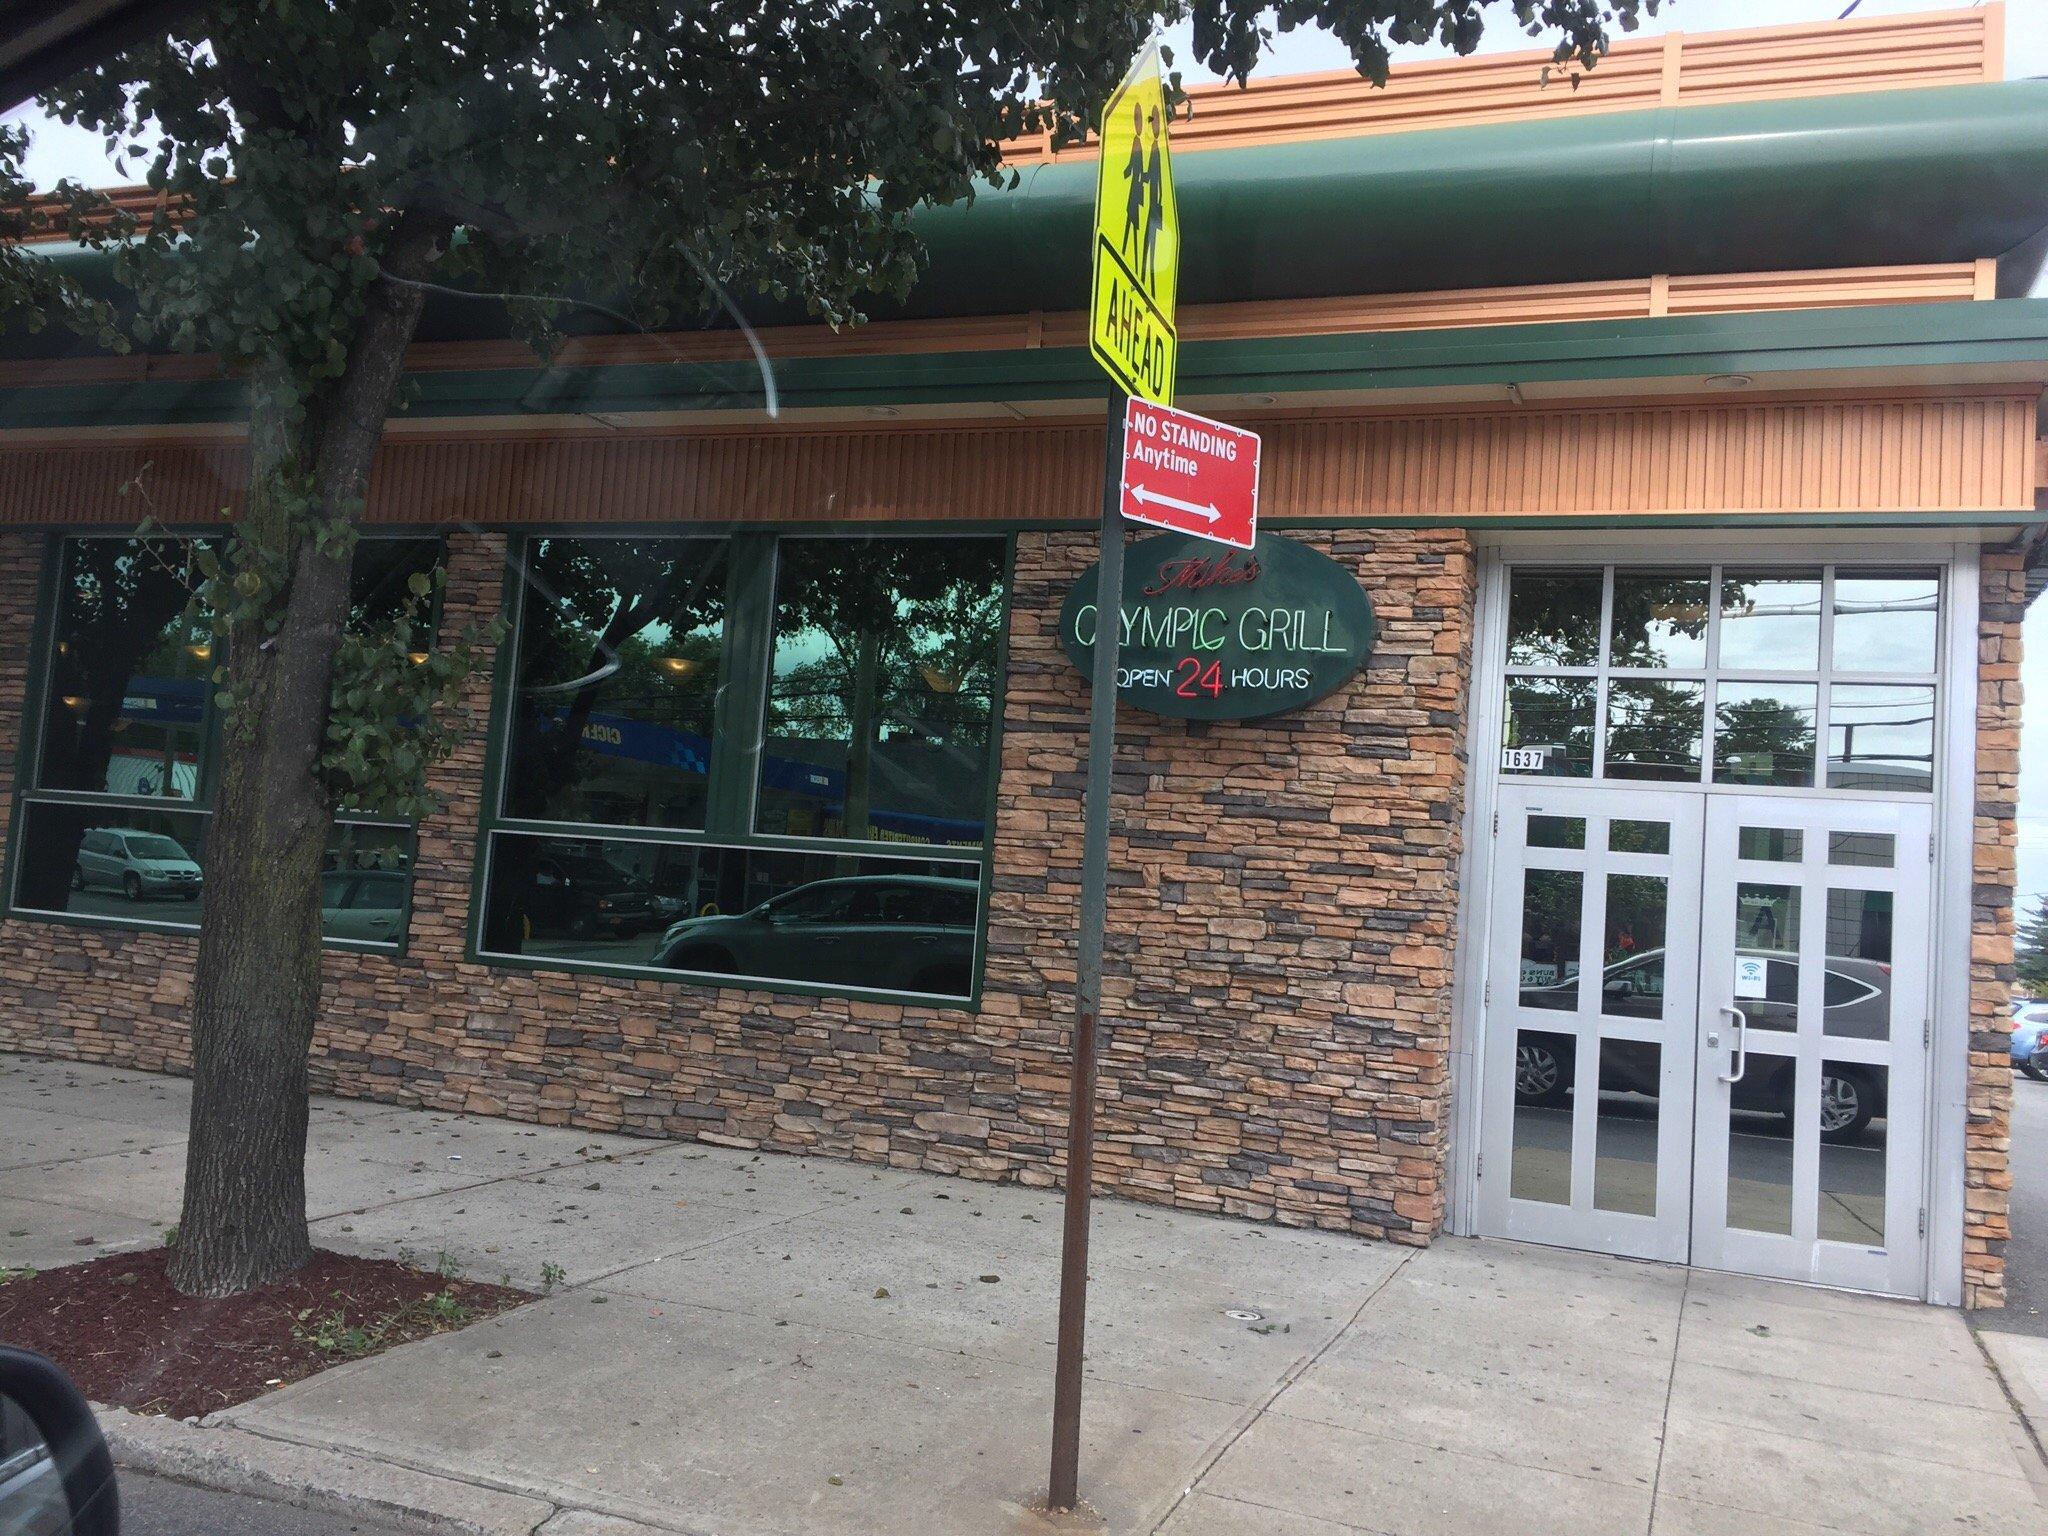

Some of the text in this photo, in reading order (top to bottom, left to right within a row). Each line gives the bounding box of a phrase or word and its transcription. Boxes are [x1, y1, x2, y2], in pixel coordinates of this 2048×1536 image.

[1106, 277, 1164, 397] AHEAD
[1132, 439, 1198, 477] Anytime
[1134, 411, 1238, 462] NO STANDING
[1075, 604, 1347, 652] OYMPIC GRILL
[1117, 657, 1310, 699] OPEN 24 HOURS
[1504, 750, 1542, 768] 1637
